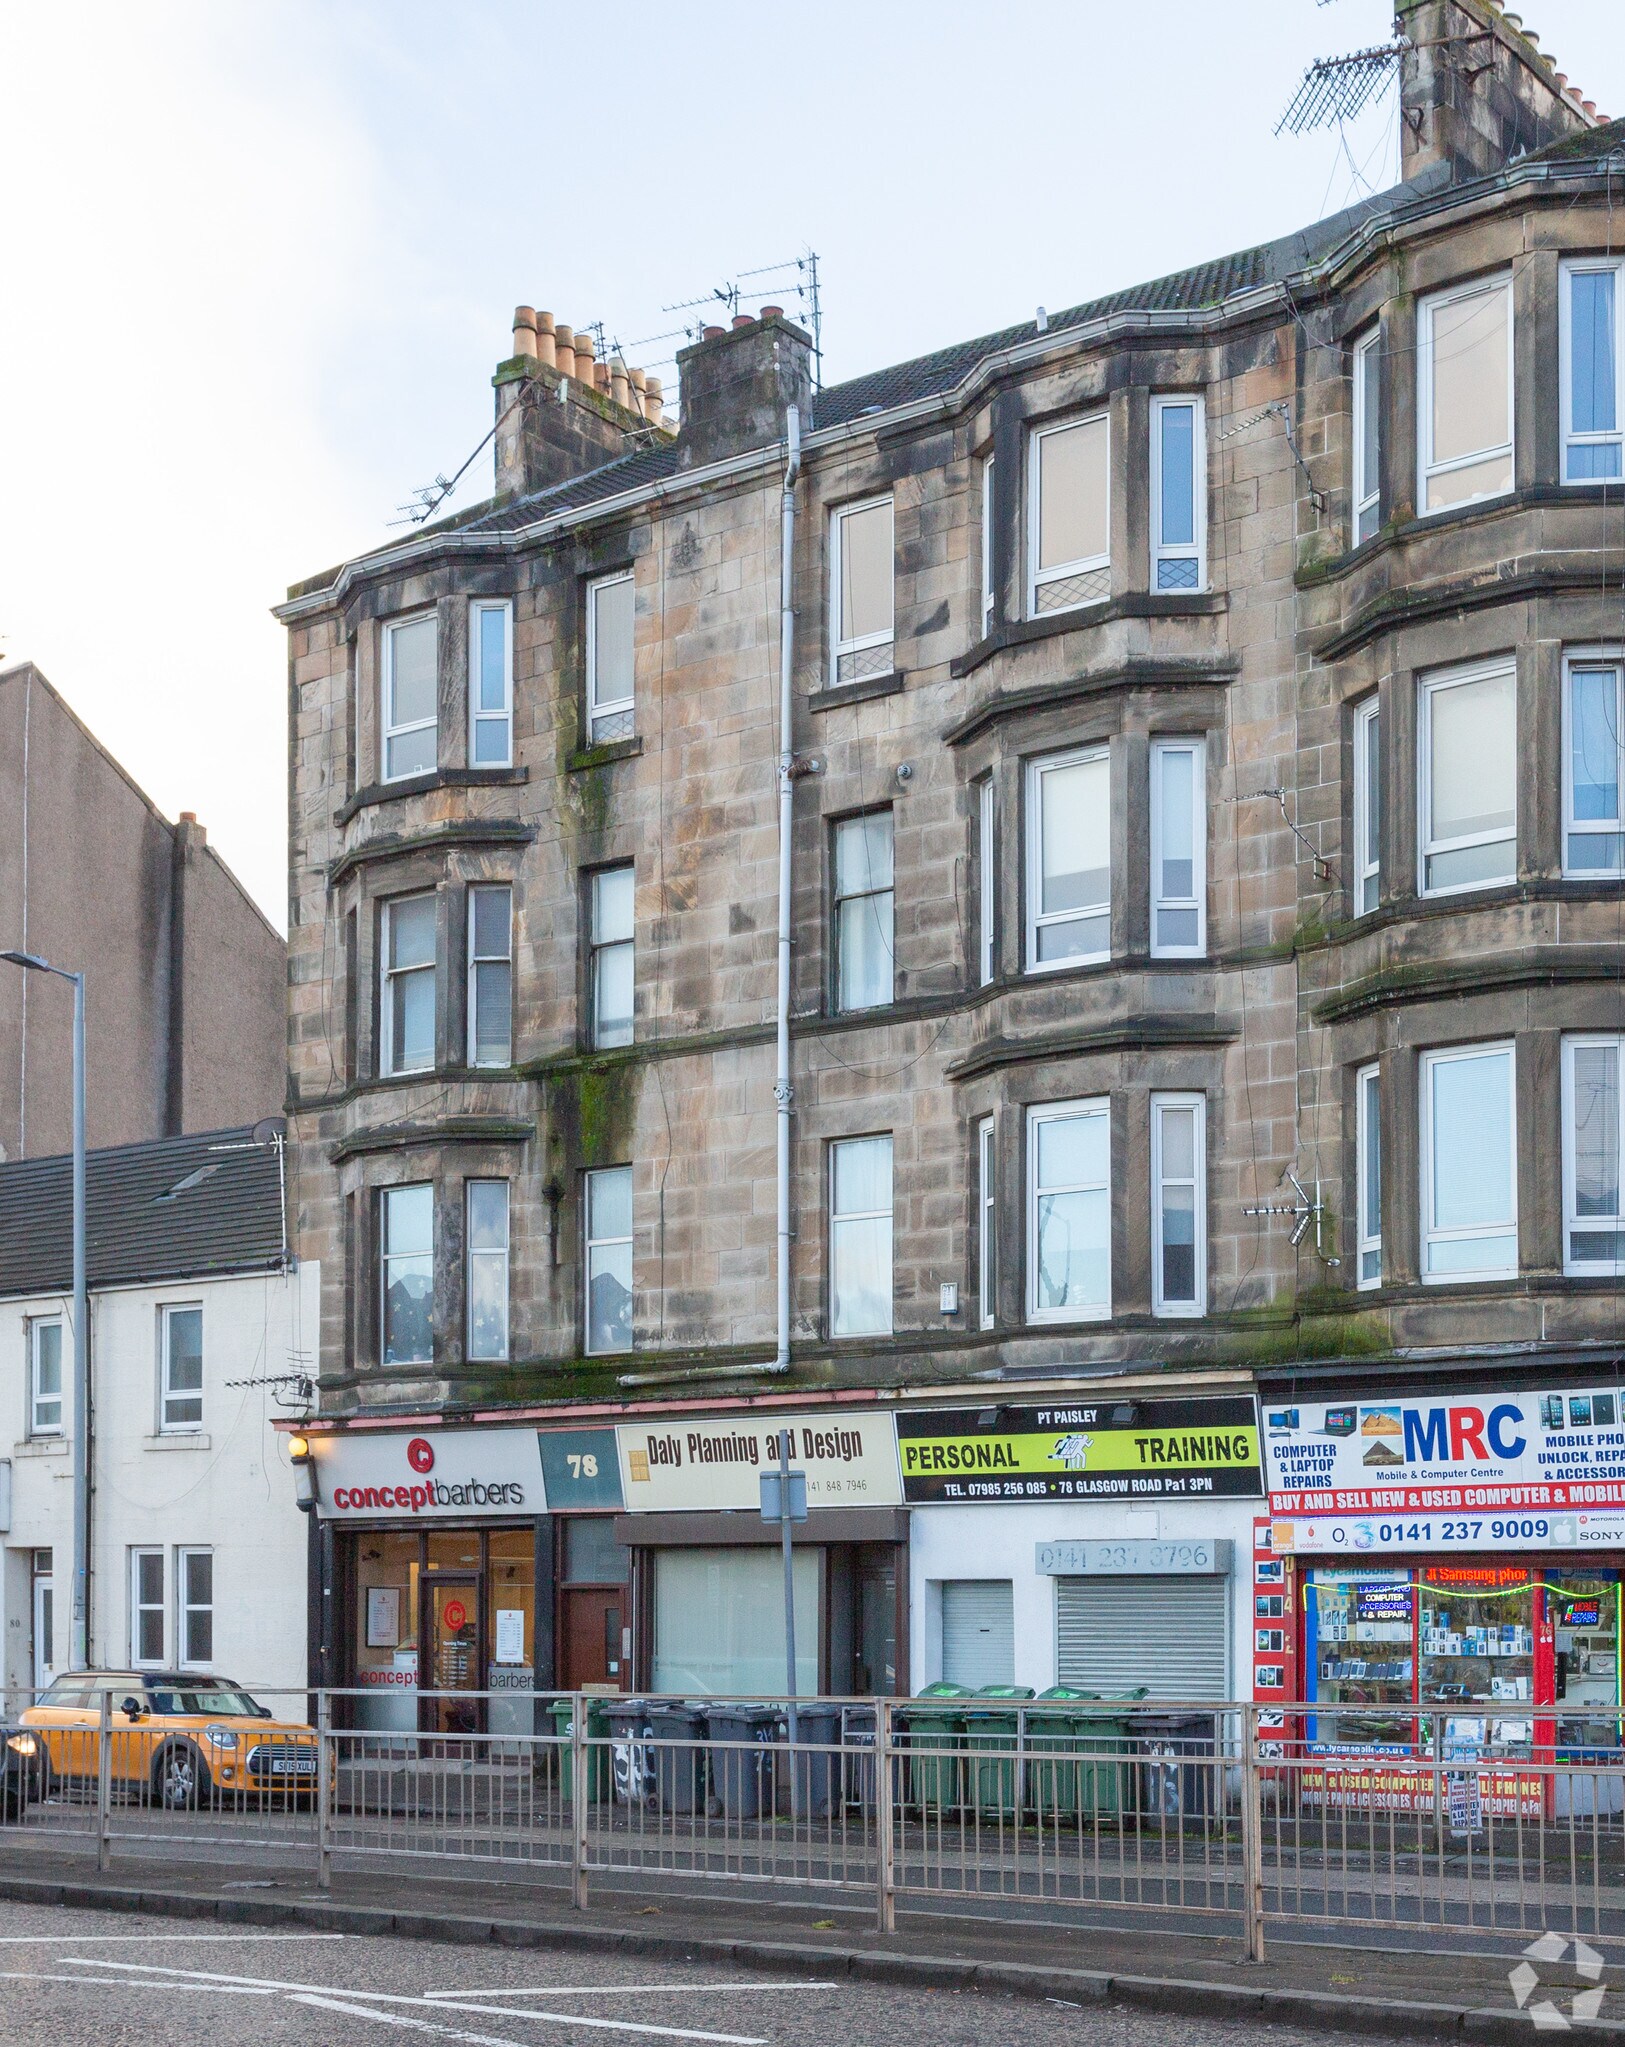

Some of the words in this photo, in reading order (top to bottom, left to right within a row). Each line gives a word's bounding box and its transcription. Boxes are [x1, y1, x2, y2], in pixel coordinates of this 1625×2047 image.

[1037, 1411, 1051, 1425] PT
[1054, 1409, 1098, 1424] PAISLEY
[1402, 1404, 1527, 1462] MRC
[647, 1435, 682, 1468] Daly
[687, 1431, 759, 1466] Planning
[802, 1426, 864, 1462] Design
[1545, 1434, 1594, 1448] MOBILE
[905, 1443, 1020, 1470] PERSONAL
[1134, 1435, 1250, 1463] TRAINING
[1273, 1444, 1337, 1459] COMPUTER
[1537, 1451, 1593, 1465] UNLOCK,
[567, 1454, 599, 1479] 78
[1280, 1461, 1289, 1473] &
[1291, 1459, 1334, 1472] LAPTOP
[1283, 1474, 1332, 1489] REPAIRS
[1376, 1470, 1408, 1481] Mobile
[1411, 1470, 1418, 1479] &
[1421, 1468, 1467, 1482] Computer
[1470, 1467, 1504, 1478] Centre
[1544, 1470, 1554, 1481] &
[826, 1480, 842, 1492] 848
[846, 1479, 868, 1491] 7946
[944, 1484, 966, 1497] TEL.
[968, 1483, 1001, 1497] 07985
[1003, 1482, 1024, 1496] 256
[1026, 1481, 1047, 1495] 085
[1059, 1481, 1073, 1494] 78
[1076, 1479, 1130, 1494] GLASGOW
[1131, 1478, 1162, 1493] ROAD
[1165, 1478, 1186, 1492] Pa1
[1189, 1477, 1213, 1492] 3PN
[1273, 1494, 1302, 1511] BUY
[1304, 1493, 1334, 1510] AND
[1337, 1491, 1370, 1509] SELL
[1371, 1490, 1405, 1509] NEW
[1408, 1492, 1421, 1507] &
[1421, 1488, 1462, 1507] USED
[1464, 1486, 1551, 1505] COMPUTER
[1553, 1488, 1567, 1503] &
[1379, 1522, 1432, 1542] 0141
[1441, 1520, 1483, 1540] 237
[1491, 1519, 1549, 1539] 9009
[1579, 1531, 1624, 1541] SONY
[1299, 1541, 1324, 1549] vodafone
[1439, 1568, 1496, 1584] Samsung
[1366, 1593, 1404, 1601] COMPUTER
[1359, 1601, 1412, 1610] ACCESSORIES
[1574, 1602, 1598, 1612] MOBILE
[1368, 1611, 1375, 1619] &
[1571, 1612, 1598, 1623] REPAIRS
[361, 1669, 419, 1688] concept
[1329, 1776, 1337, 1788] &
[1530, 1799, 1541, 1815] Fa
